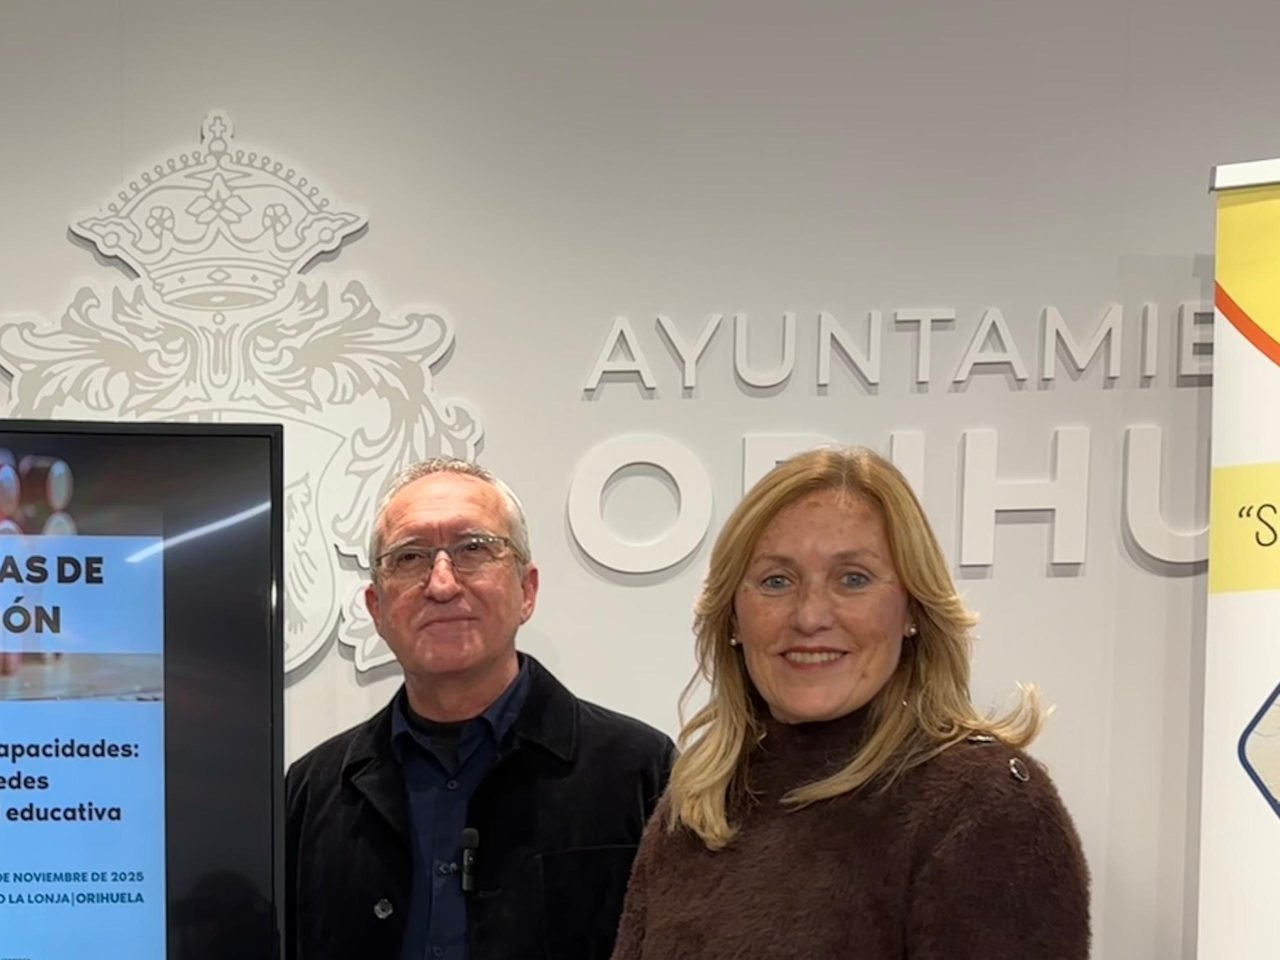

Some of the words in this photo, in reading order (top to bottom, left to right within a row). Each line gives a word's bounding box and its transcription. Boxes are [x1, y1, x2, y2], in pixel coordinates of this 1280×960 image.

[569, 424, 1210, 573] OHU
[57, 556, 104, 584] DE
[5, 802, 122, 822] educativa
[12, 871, 88, 883] NOVIEMBRE
[91, 871, 108, 883] DE
[110, 871, 145, 882] 2025
[8, 893, 25, 905] LA
